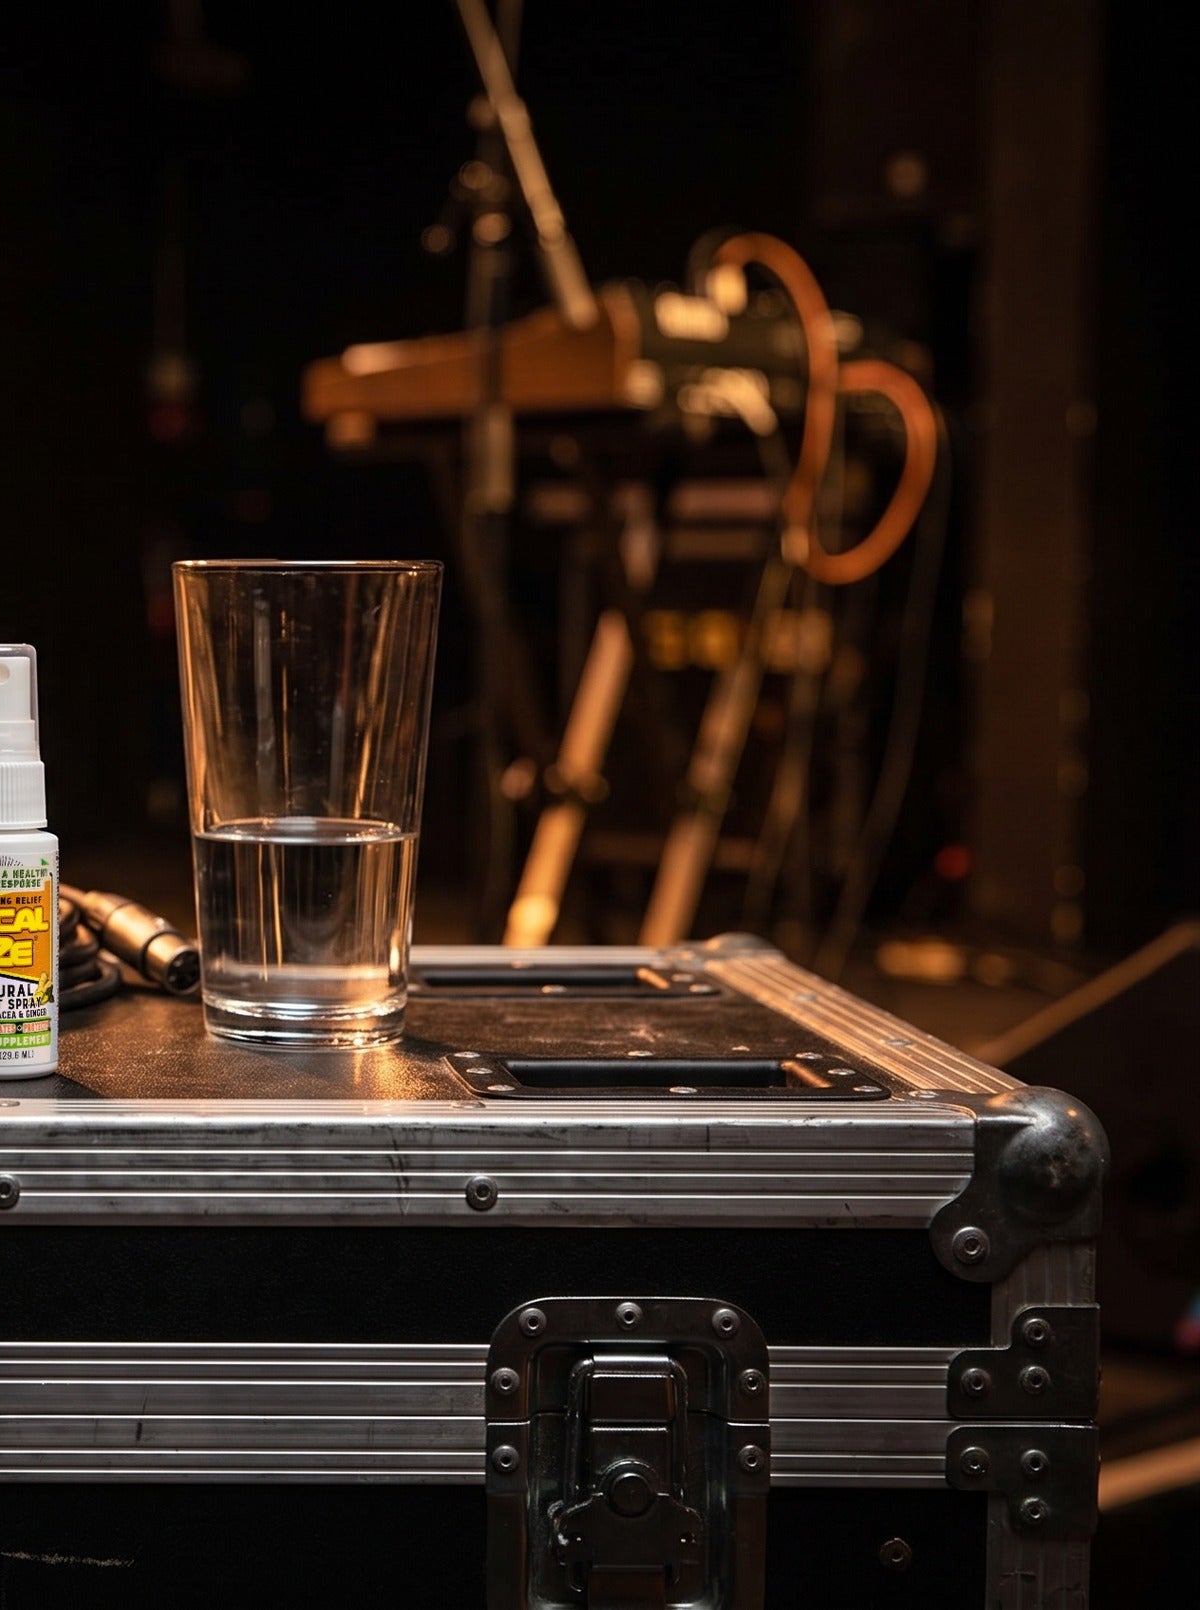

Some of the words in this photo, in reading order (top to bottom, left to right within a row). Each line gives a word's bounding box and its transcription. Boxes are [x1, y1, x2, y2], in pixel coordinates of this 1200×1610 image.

[2, 870, 8, 878] A
[16, 896, 42, 904] RELIEF
[8, 997, 42, 1009] SPRAY
